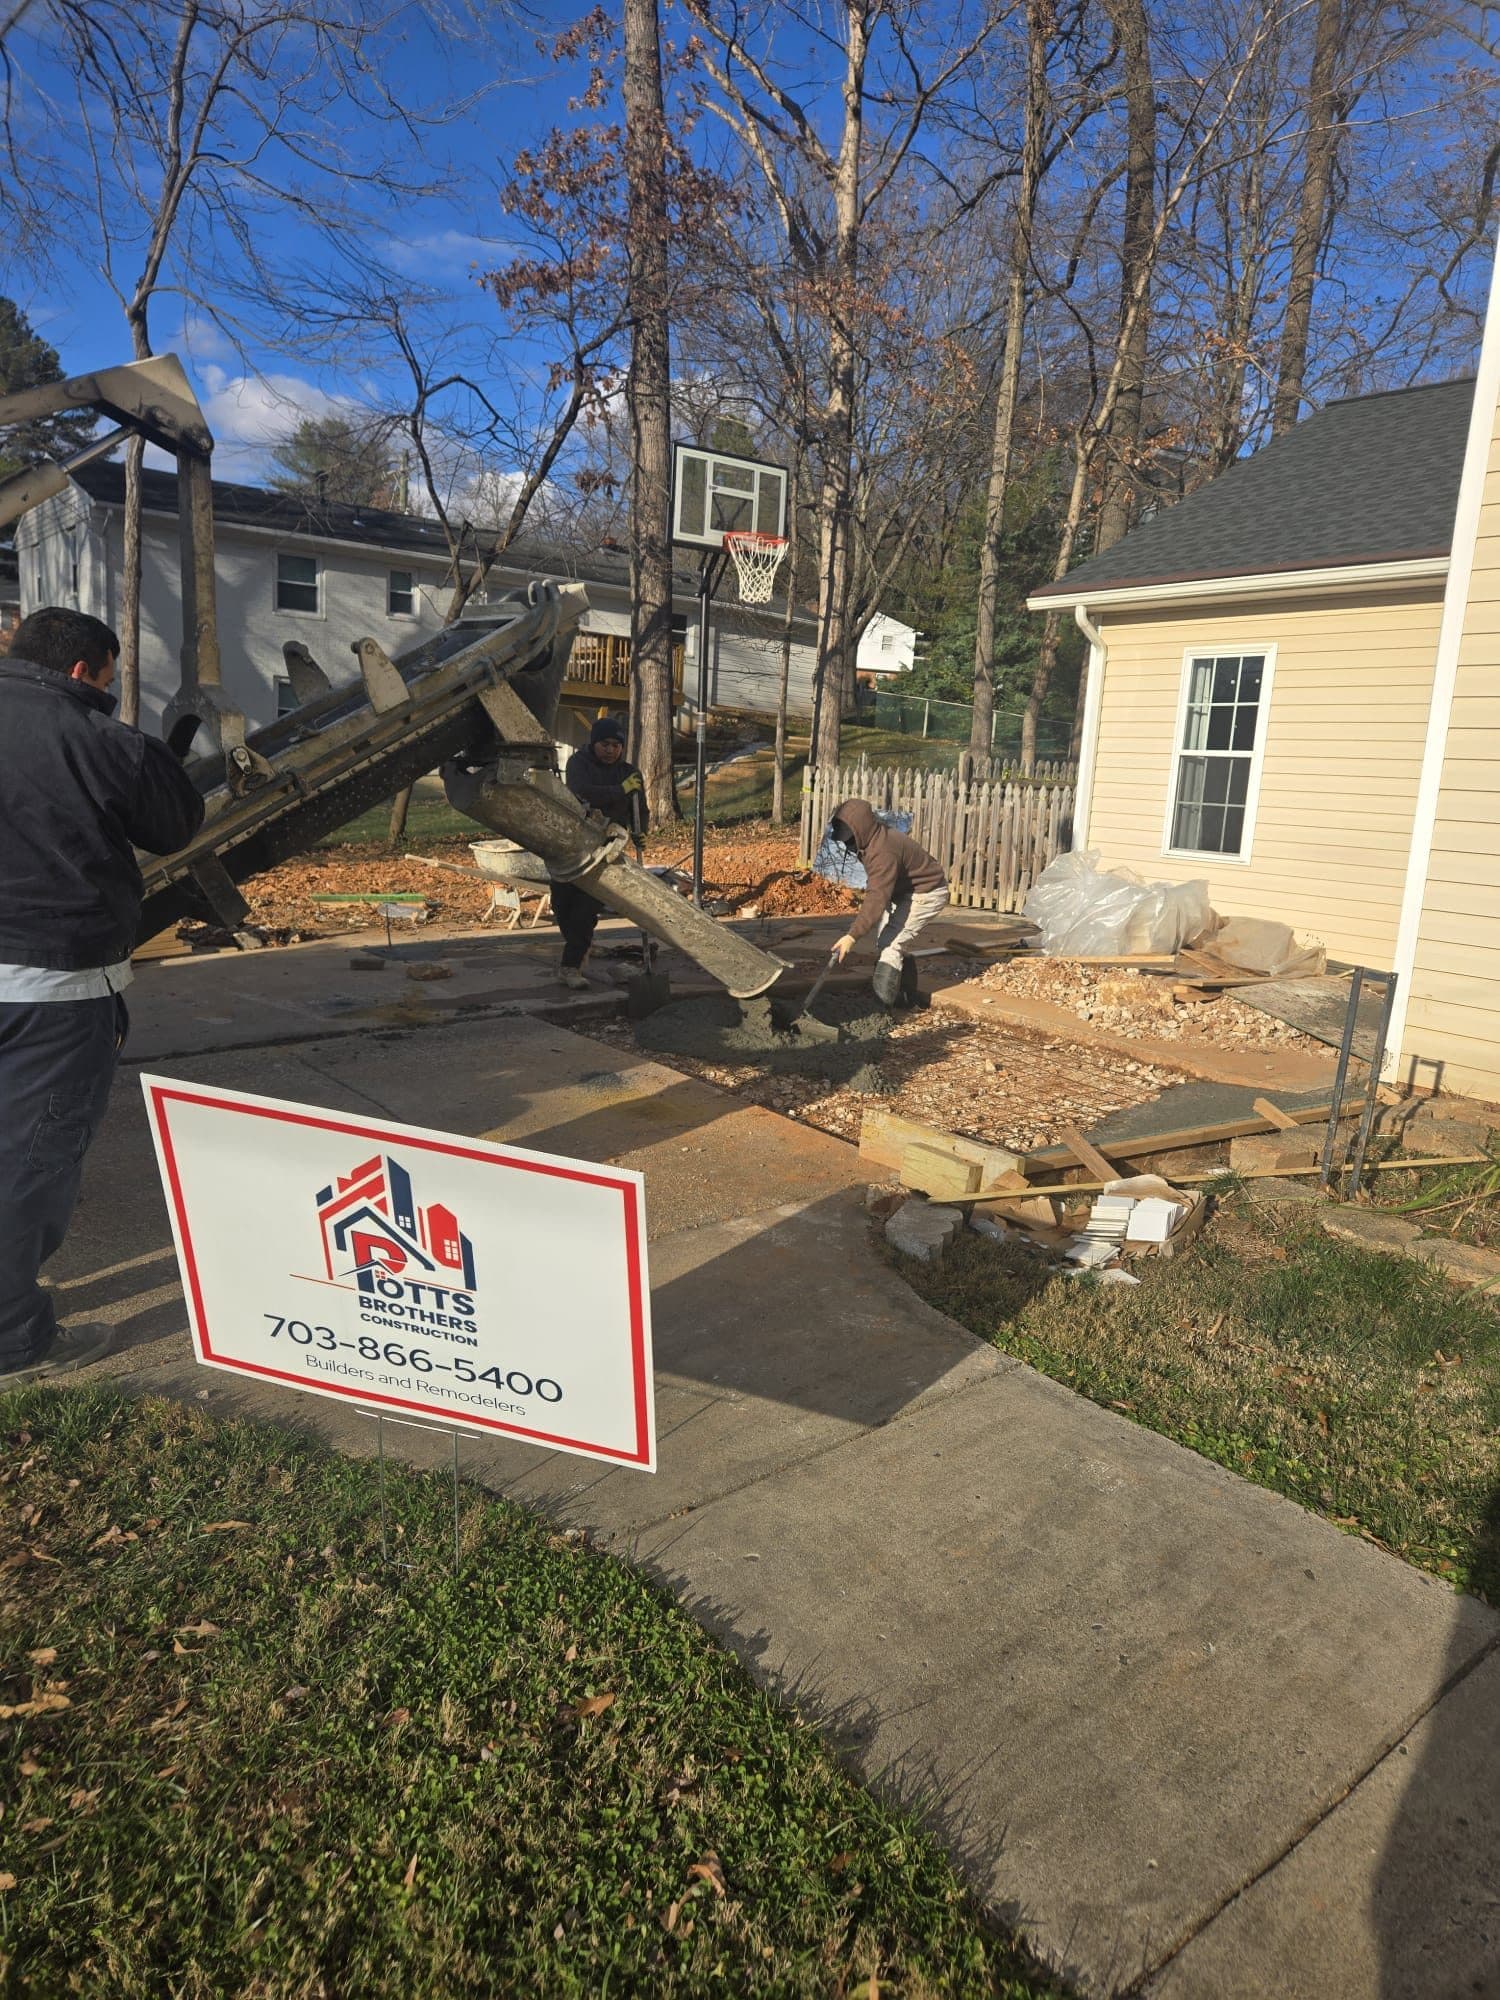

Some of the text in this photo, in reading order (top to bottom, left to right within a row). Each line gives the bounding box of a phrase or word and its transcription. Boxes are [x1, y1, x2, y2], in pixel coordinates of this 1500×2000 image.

[359, 1295, 477, 1333] BROTHERS
[360, 1313, 478, 1347] CONSTRUCTION
[263, 1313, 563, 1403] 703-866-5400
[305, 1354, 526, 1416] Builders and Remodelers
